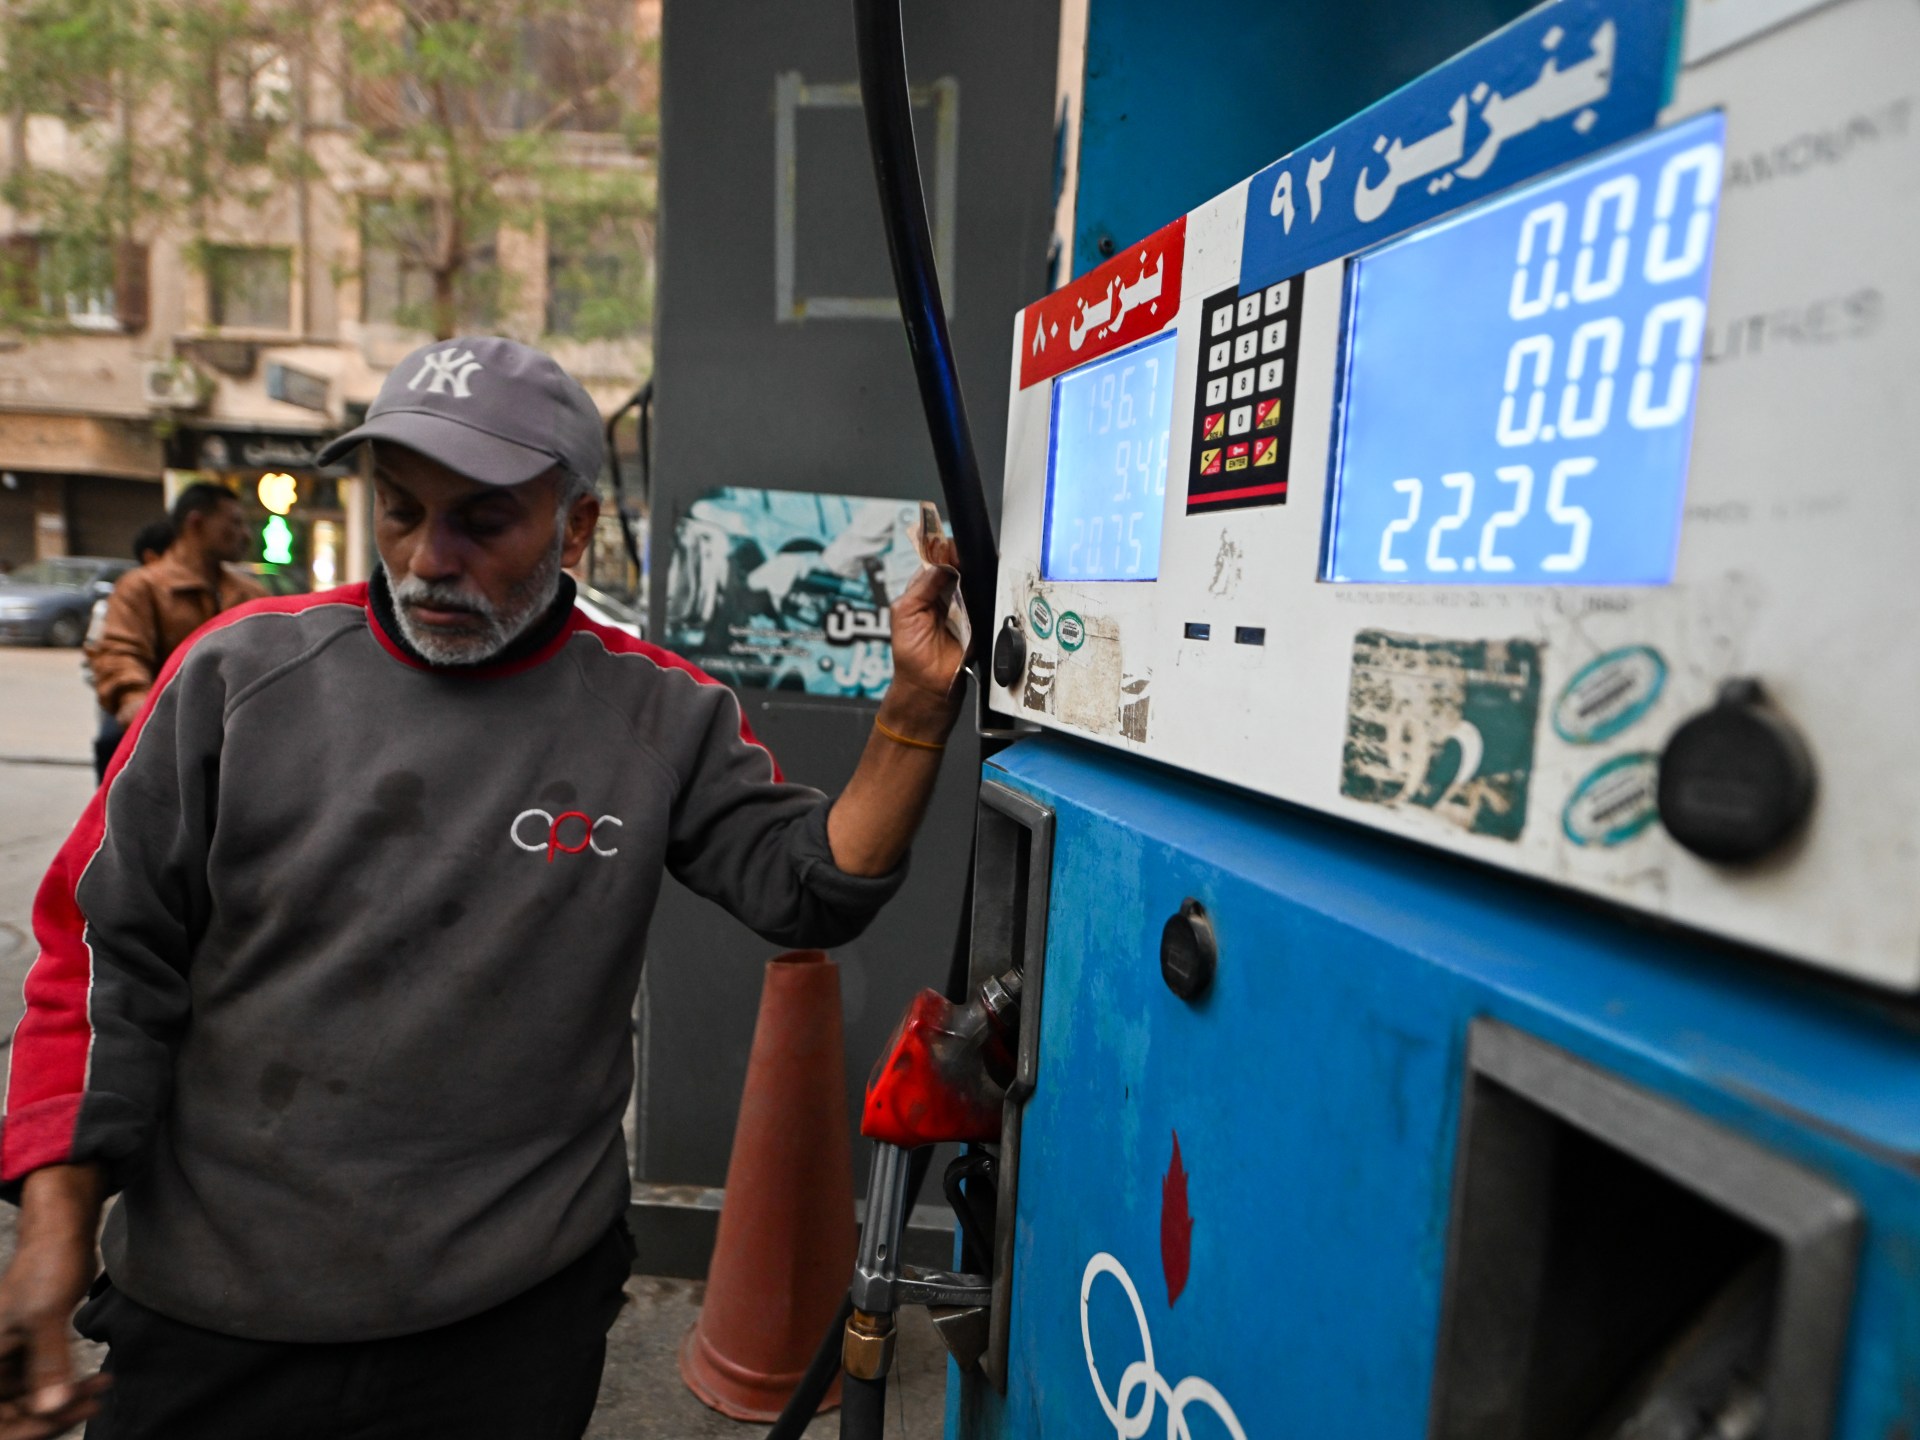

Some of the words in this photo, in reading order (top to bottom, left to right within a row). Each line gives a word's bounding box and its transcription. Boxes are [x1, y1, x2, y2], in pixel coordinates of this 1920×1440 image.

[1353, 19, 1617, 224] بنزين
[1269, 145, 1336, 236] ٩٢
[1508, 142, 1722, 321] 0.00
[1069, 250, 1164, 352] بنزين
[1220, 313, 1226, 328] 1
[1246, 302, 1253, 317] 2
[1274, 290, 1281, 306] 3
[1032, 311, 1059, 358] ٨٠
[1216, 349, 1223, 363] 4
[1243, 339, 1250, 354] 5
[1271, 329, 1278, 344] 6
[407, 347, 483, 398] NY
[1214, 384, 1220, 399] 7
[1240, 376, 1247, 391] 8
[1268, 367, 1275, 383] 9
[1495, 296, 1706, 448] 0.00
[1205, 417, 1212, 430] C
[1237, 413, 1244, 428] 0
[1257, 402, 1266, 417] C
[1228, 457, 1246, 469] ENTER
[1378, 456, 1599, 572] 22.25
